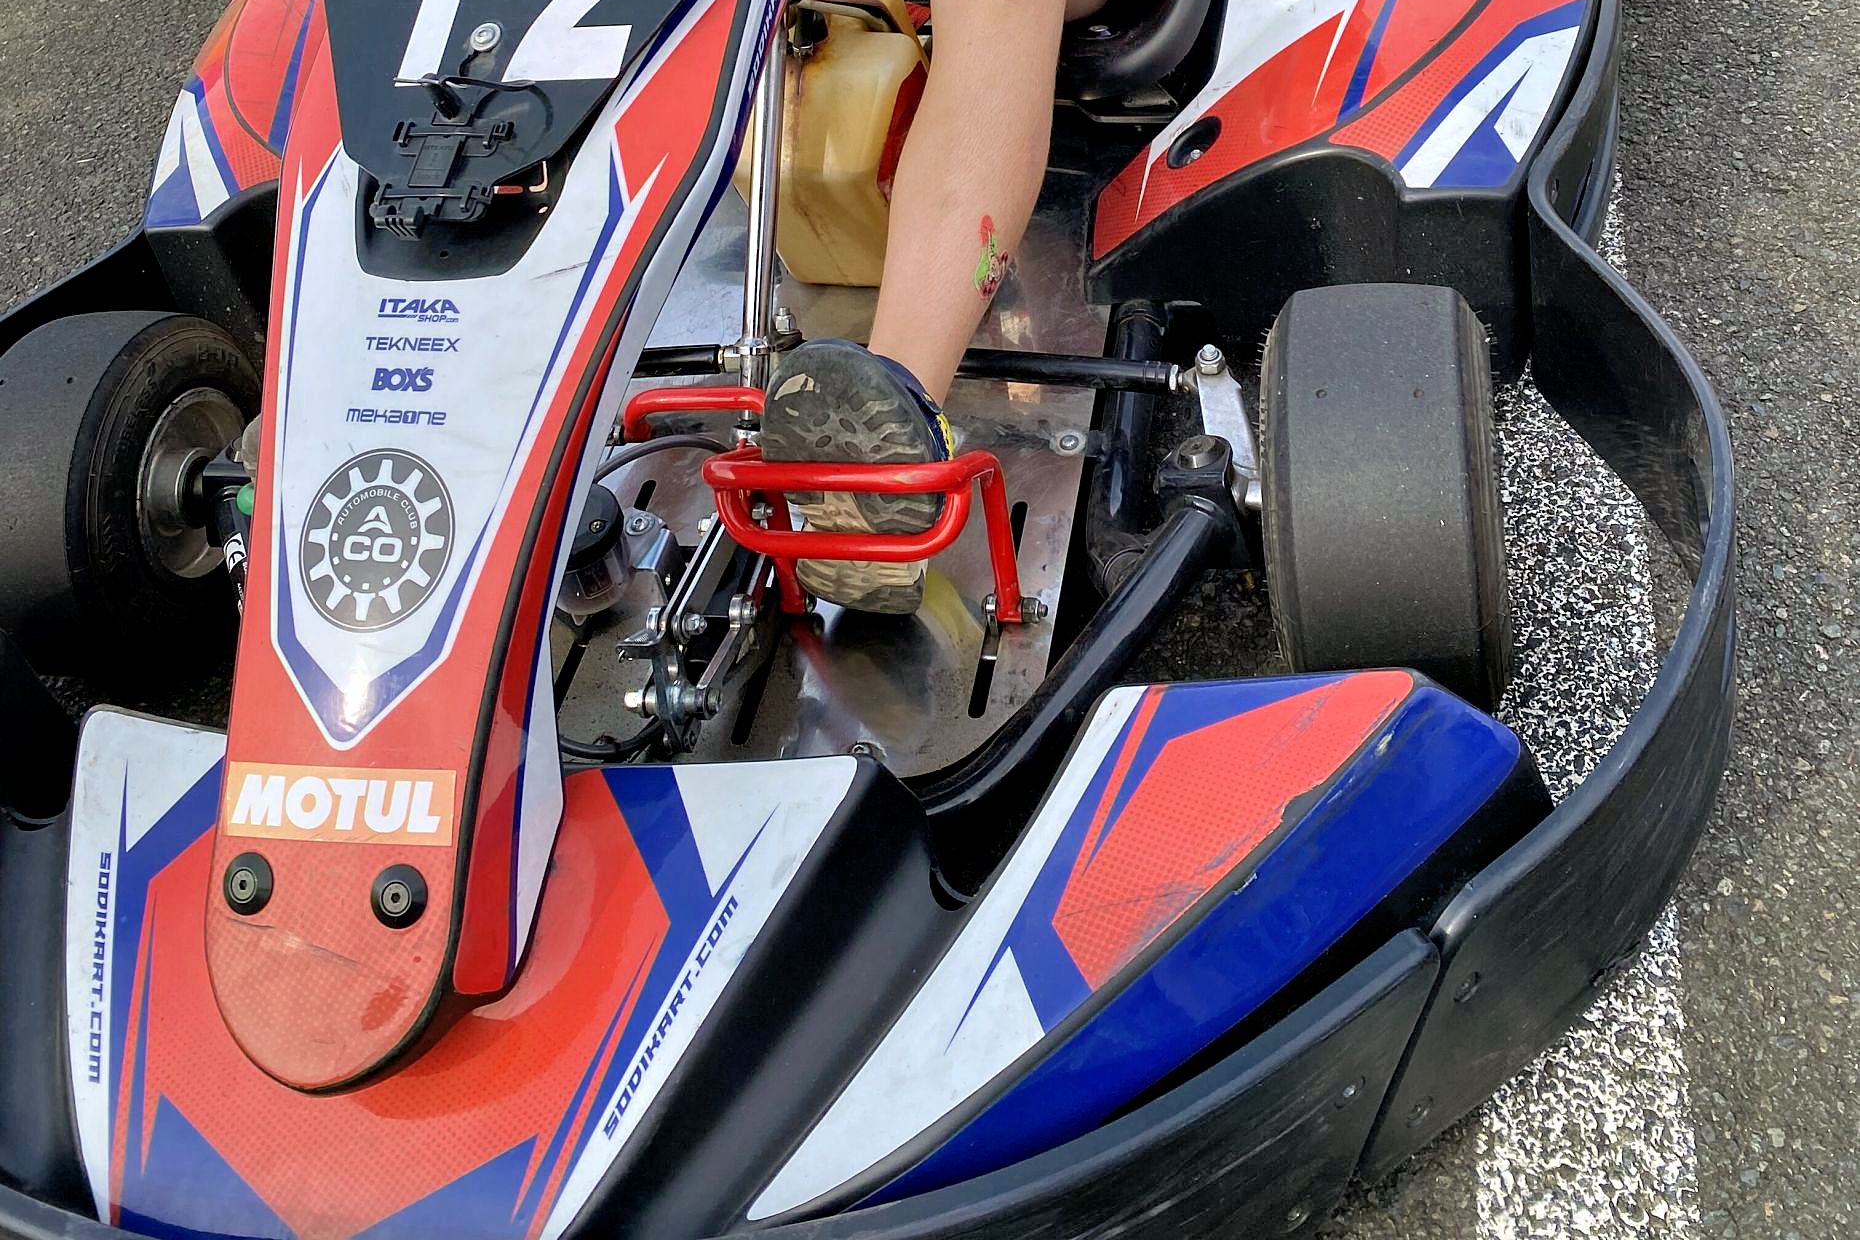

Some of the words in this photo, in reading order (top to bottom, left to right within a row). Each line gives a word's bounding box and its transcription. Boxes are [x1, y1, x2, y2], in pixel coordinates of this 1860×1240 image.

[378, 298, 460, 314] ITAKA
[366, 336, 461, 353] TEKNEEX
[337, 488, 401, 526] AUTOMOBILE
[400, 499, 418, 529] CLUB
[231, 773, 441, 833] MOTUL
